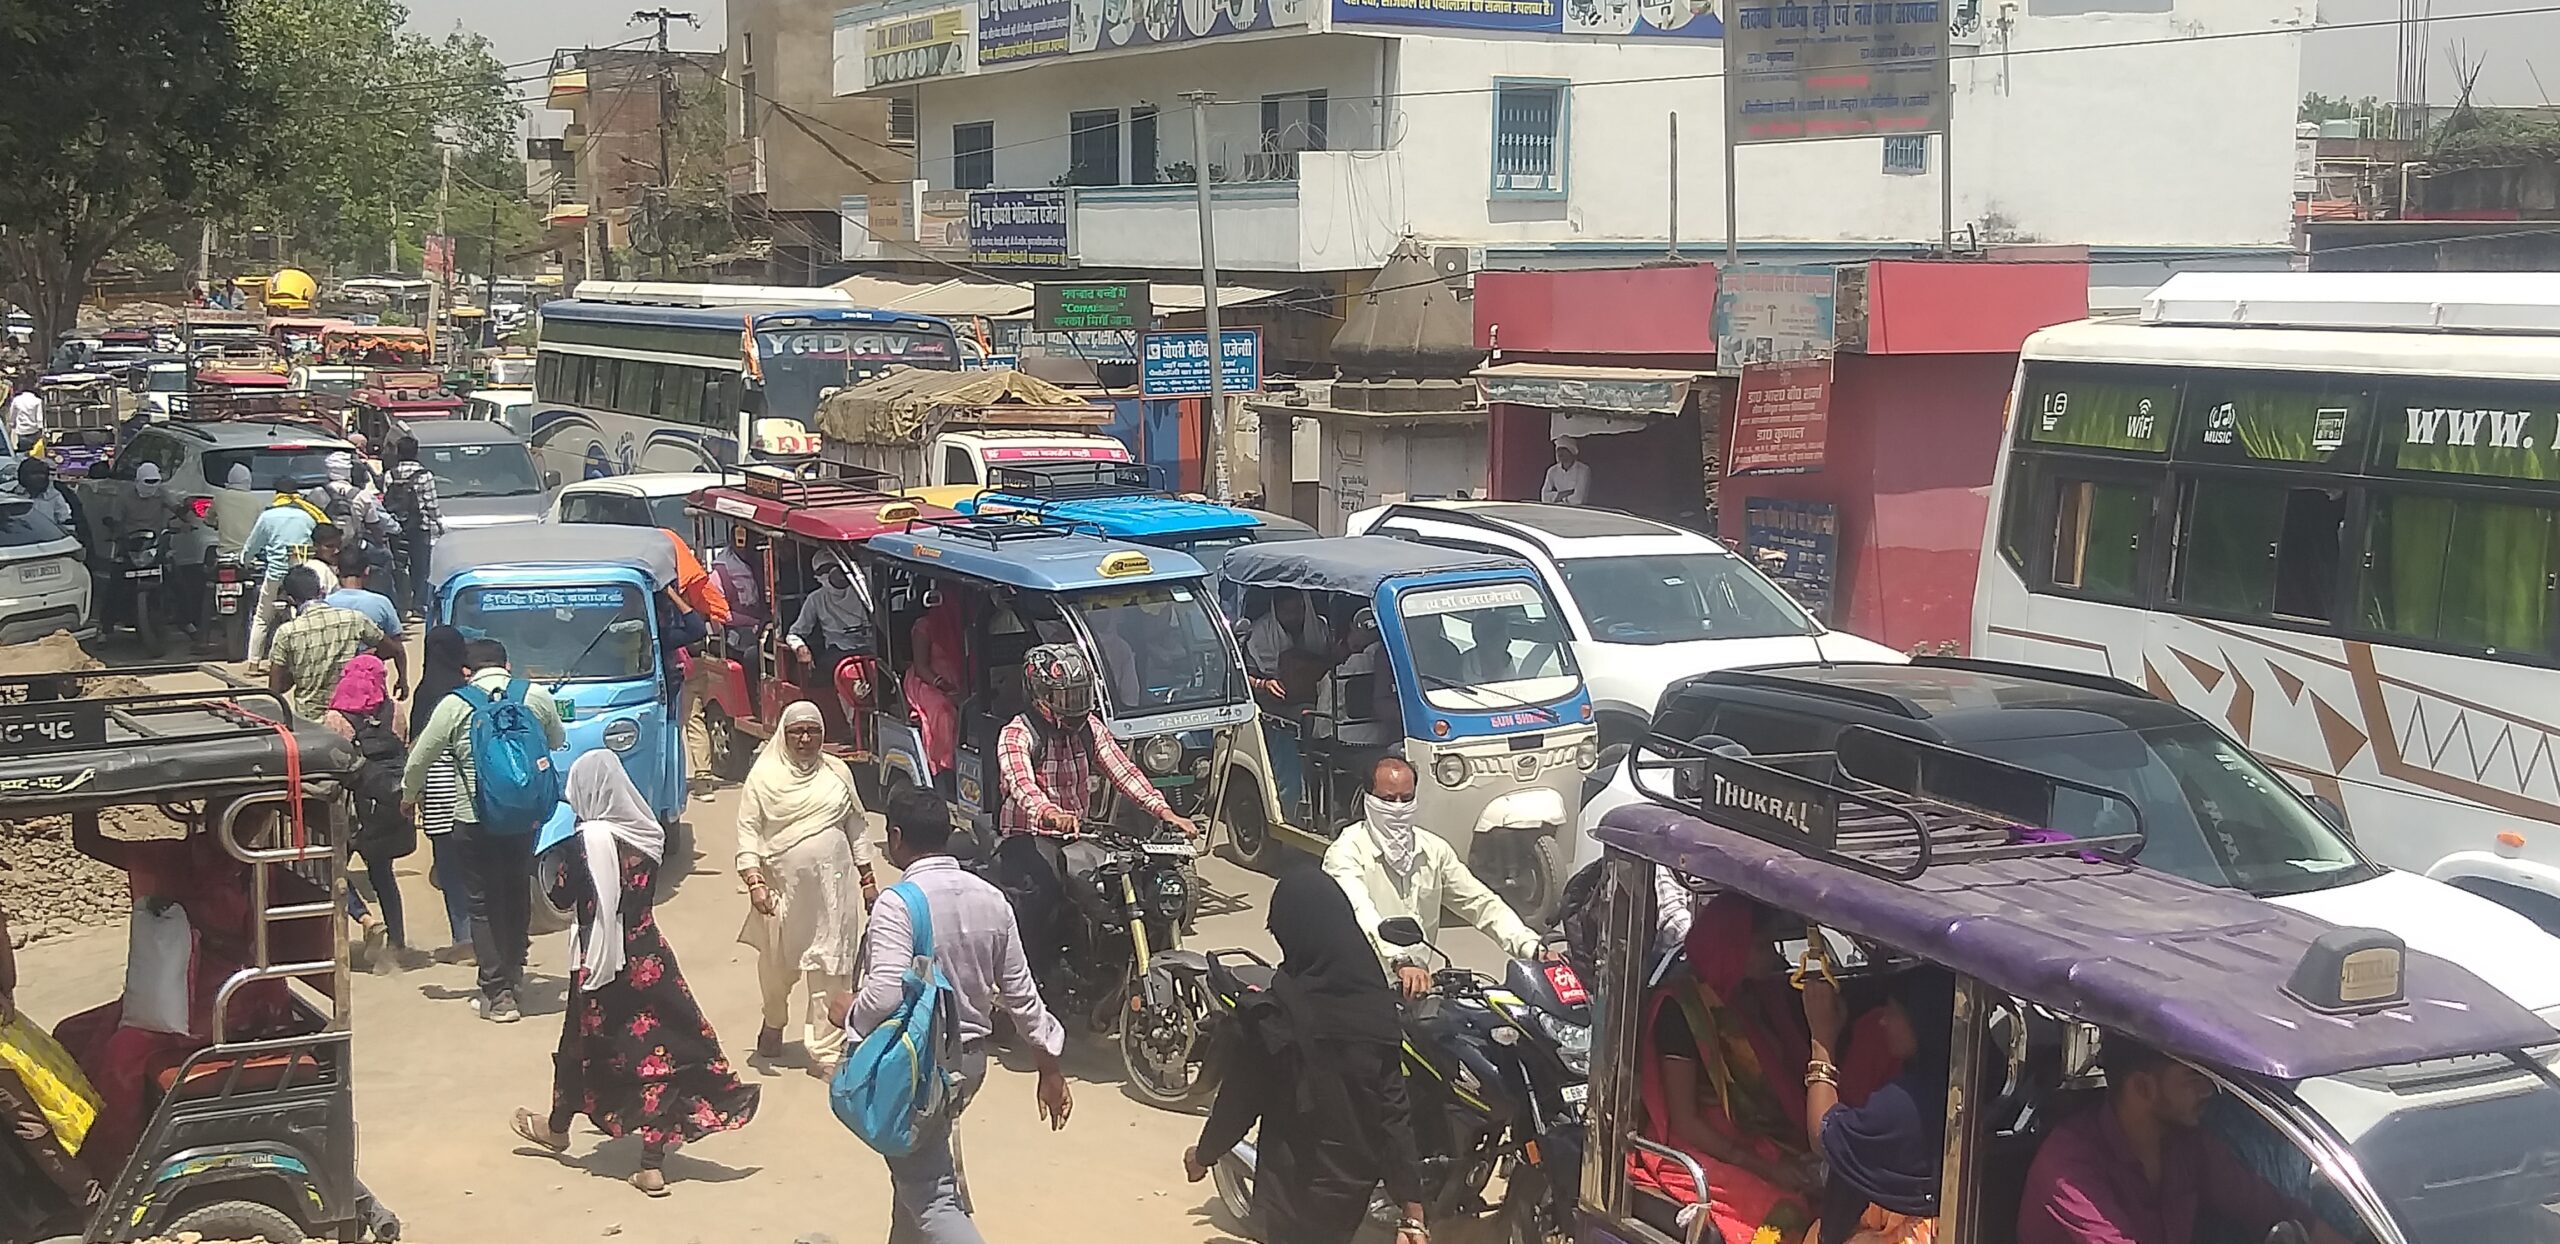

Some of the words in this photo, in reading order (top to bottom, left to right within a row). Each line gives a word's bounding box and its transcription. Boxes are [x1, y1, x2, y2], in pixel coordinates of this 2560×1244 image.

[765, 332, 909, 355] YADAV
[1774, 427, 1806, 443] कुणाल
[2127, 415, 2154, 439] WiFi
[2406, 408, 2534, 449] WWW.
[2203, 431, 2232, 444] MUSIC
[1157, 713, 1209, 727] RAHAGIR
[1490, 715, 1514, 728] SUN
[1714, 774, 1810, 834] THUKRAL
